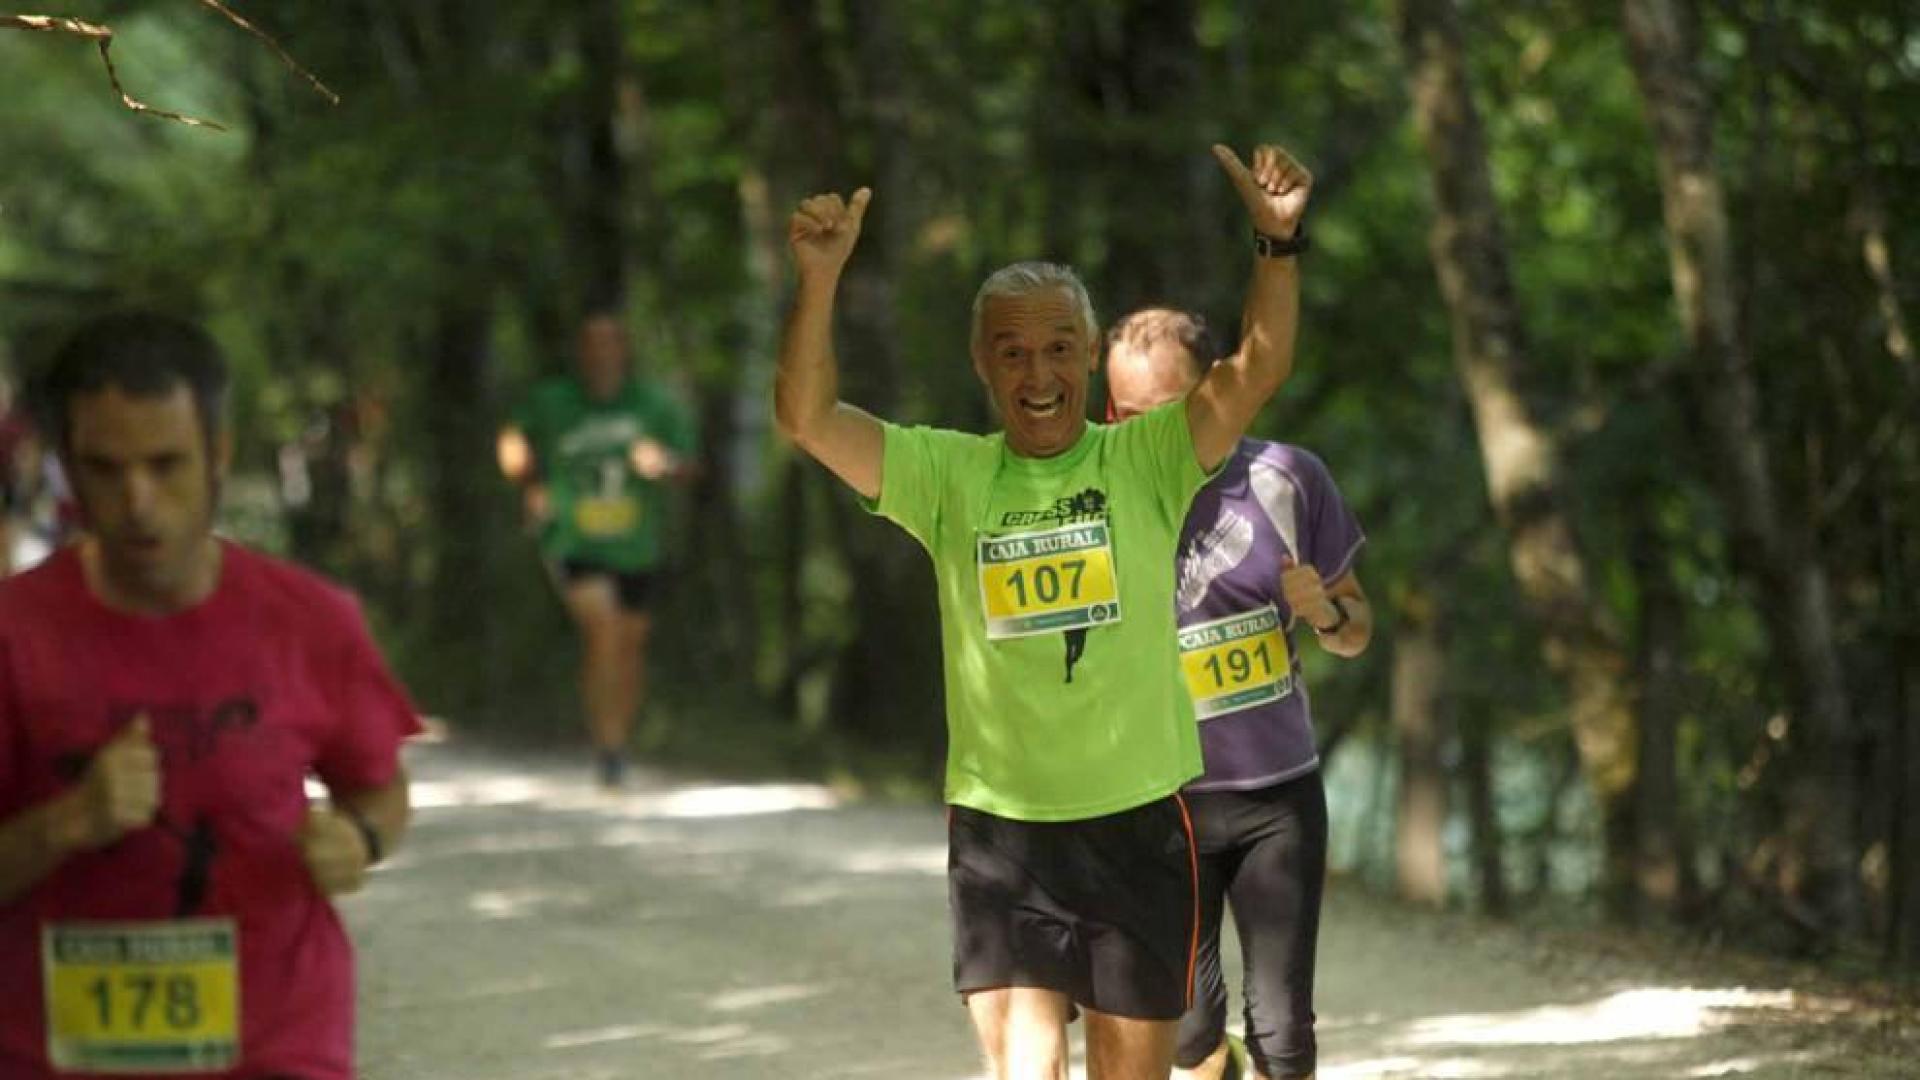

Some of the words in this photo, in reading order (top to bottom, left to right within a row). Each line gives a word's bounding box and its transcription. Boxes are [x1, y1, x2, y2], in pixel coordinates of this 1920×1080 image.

[989, 540, 1030, 559] CAJA
[1032, 527, 1100, 554] RURAL
[1006, 559, 1086, 607] 107
[1179, 628, 1222, 650] CAJA
[1225, 614, 1276, 639] RURA
[1203, 641, 1272, 688] 191
[84, 974, 202, 1031] 178
